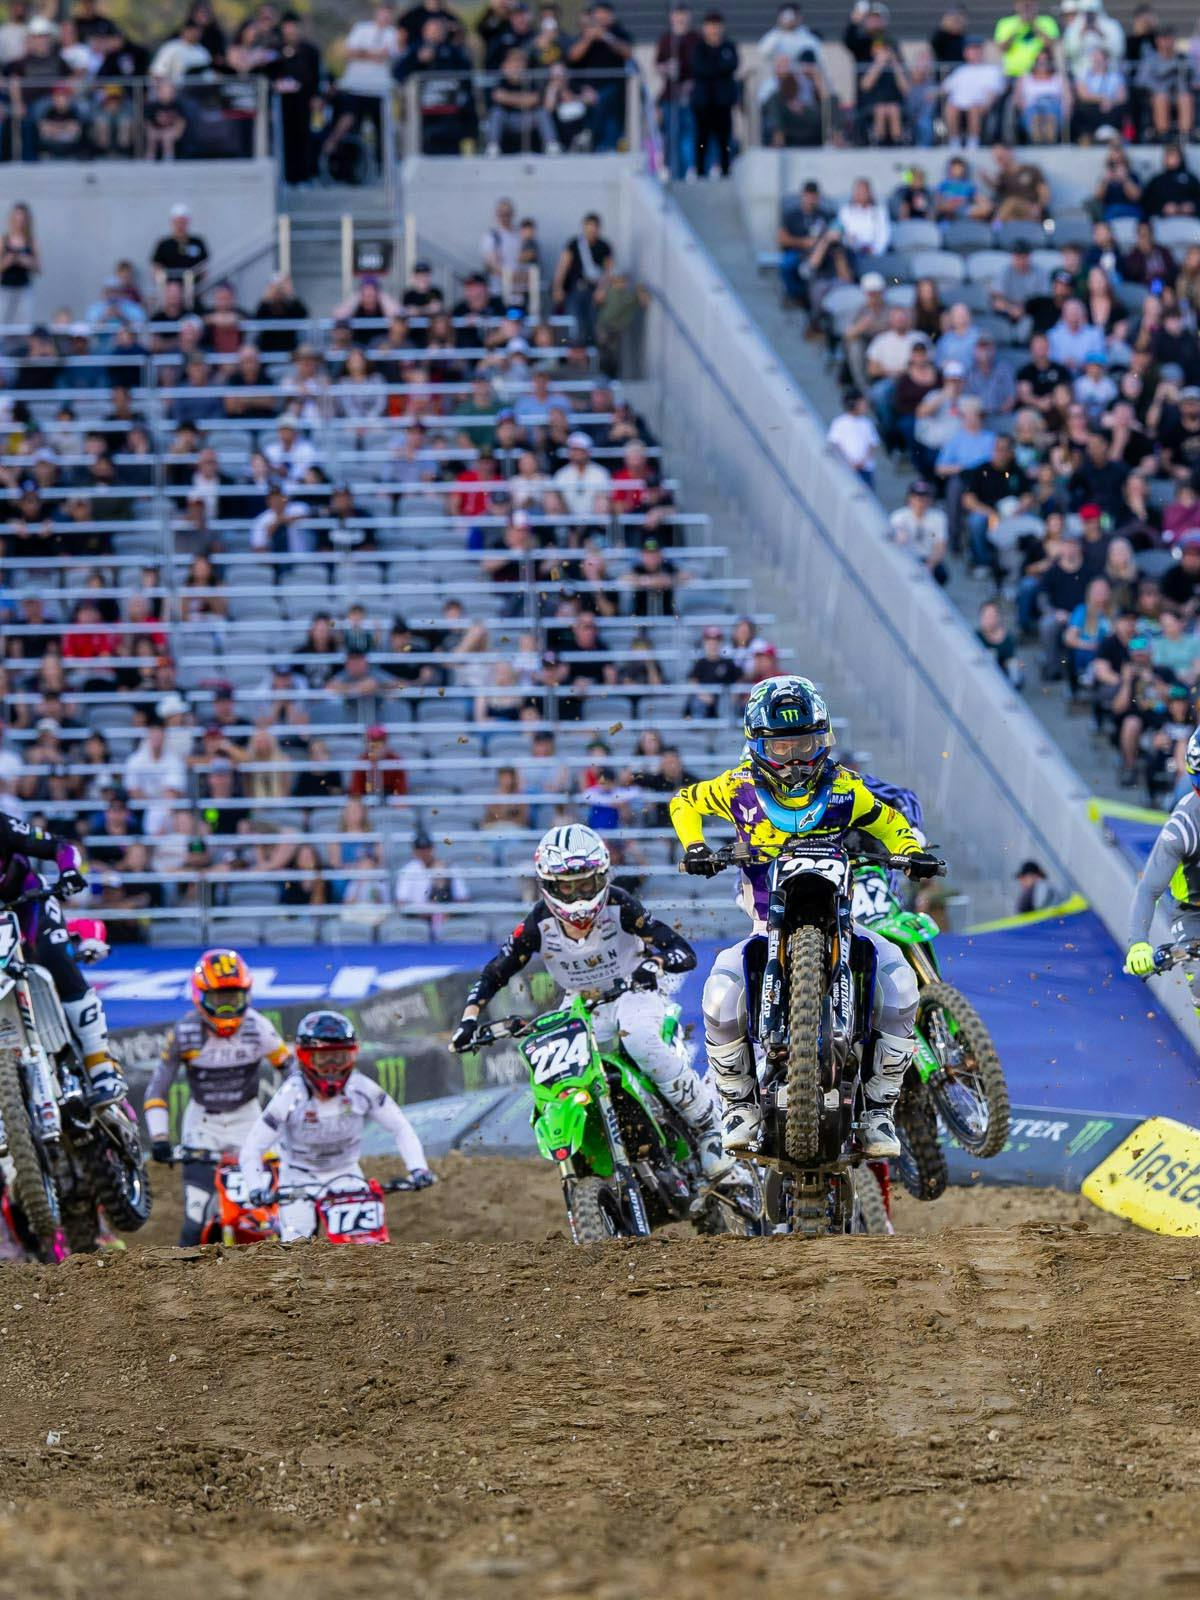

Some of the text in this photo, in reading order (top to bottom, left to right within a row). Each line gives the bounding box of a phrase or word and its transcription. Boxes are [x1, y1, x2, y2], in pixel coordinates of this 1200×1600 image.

[851, 877, 892, 919] 42
[764, 974, 775, 1018] DUNLOP
[840, 974, 849, 1018] DUNLOP
[531, 1031, 591, 1085] 224
[327, 1201, 385, 1235] 173
[629, 1188, 646, 1233] DUNLOP
